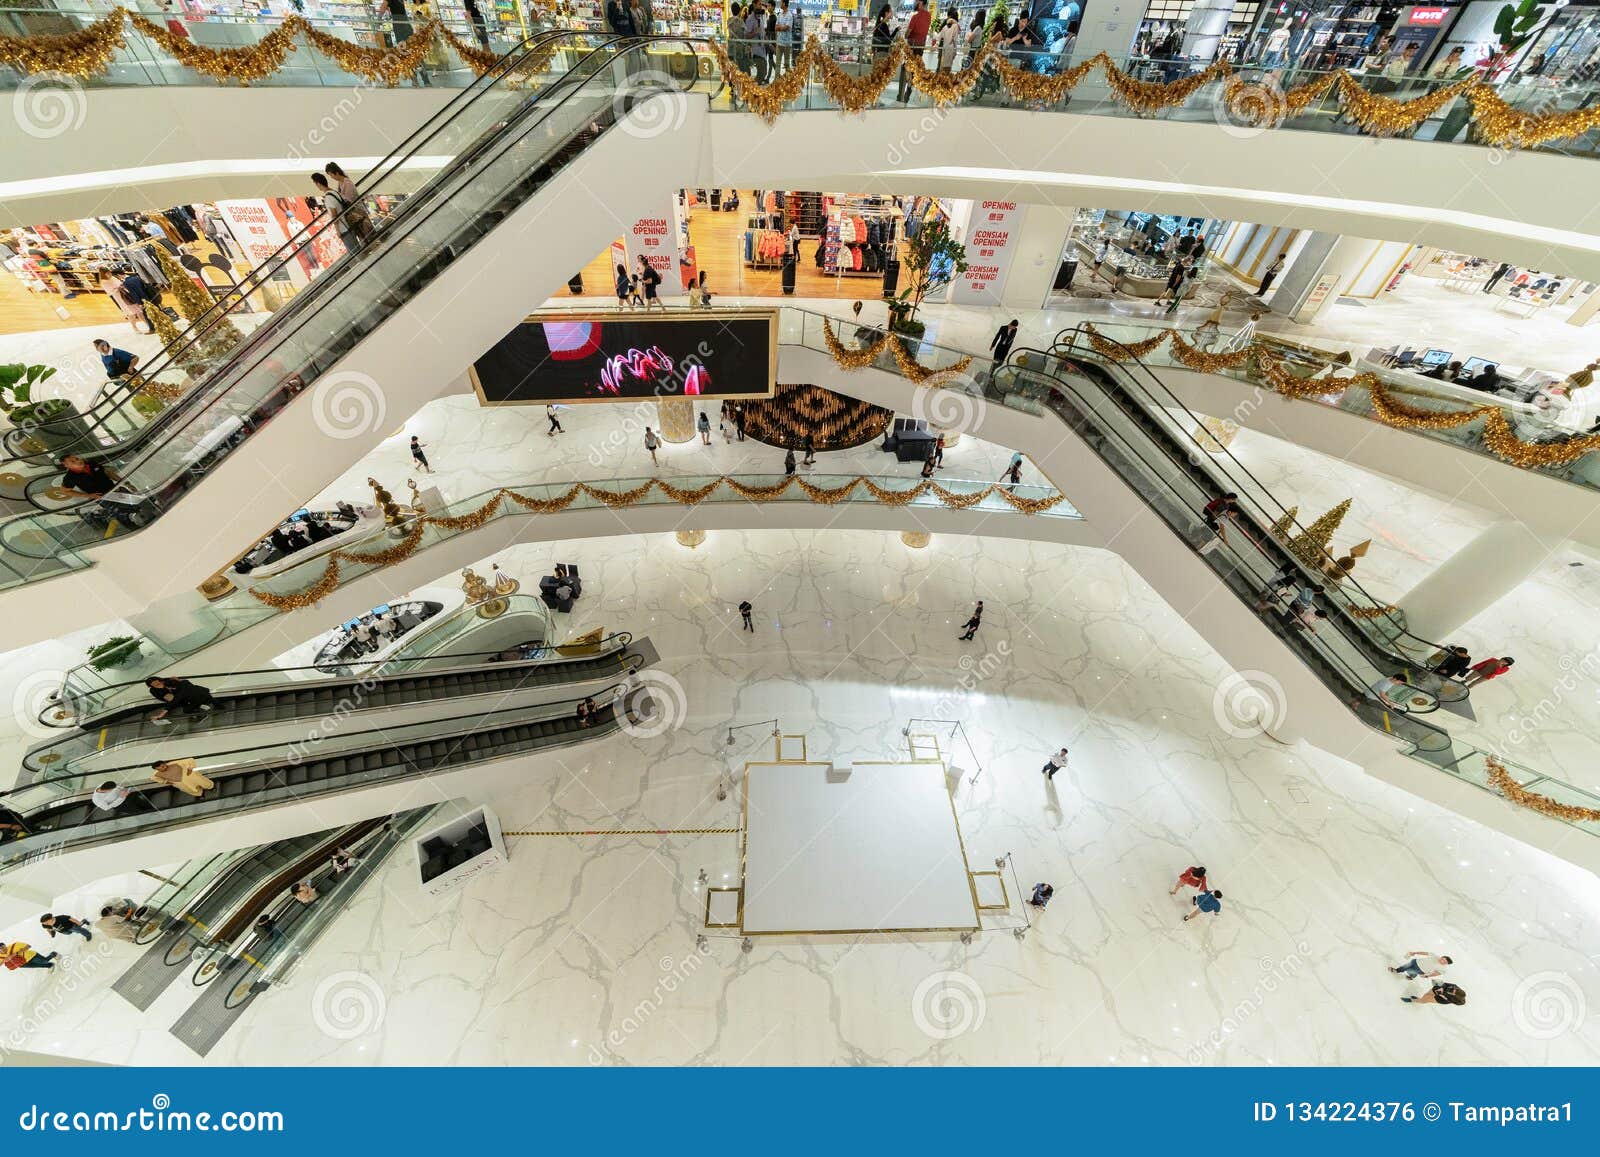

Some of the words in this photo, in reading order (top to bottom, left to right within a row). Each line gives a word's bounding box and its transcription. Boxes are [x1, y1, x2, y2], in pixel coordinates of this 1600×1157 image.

[982, 201, 1016, 211] OPENING!
[633, 227, 668, 235] OPENING!
[975, 230, 1009, 239] ICONSIAM
[973, 238, 1007, 247] OPENING!
[965, 272, 998, 280] OPENING!
